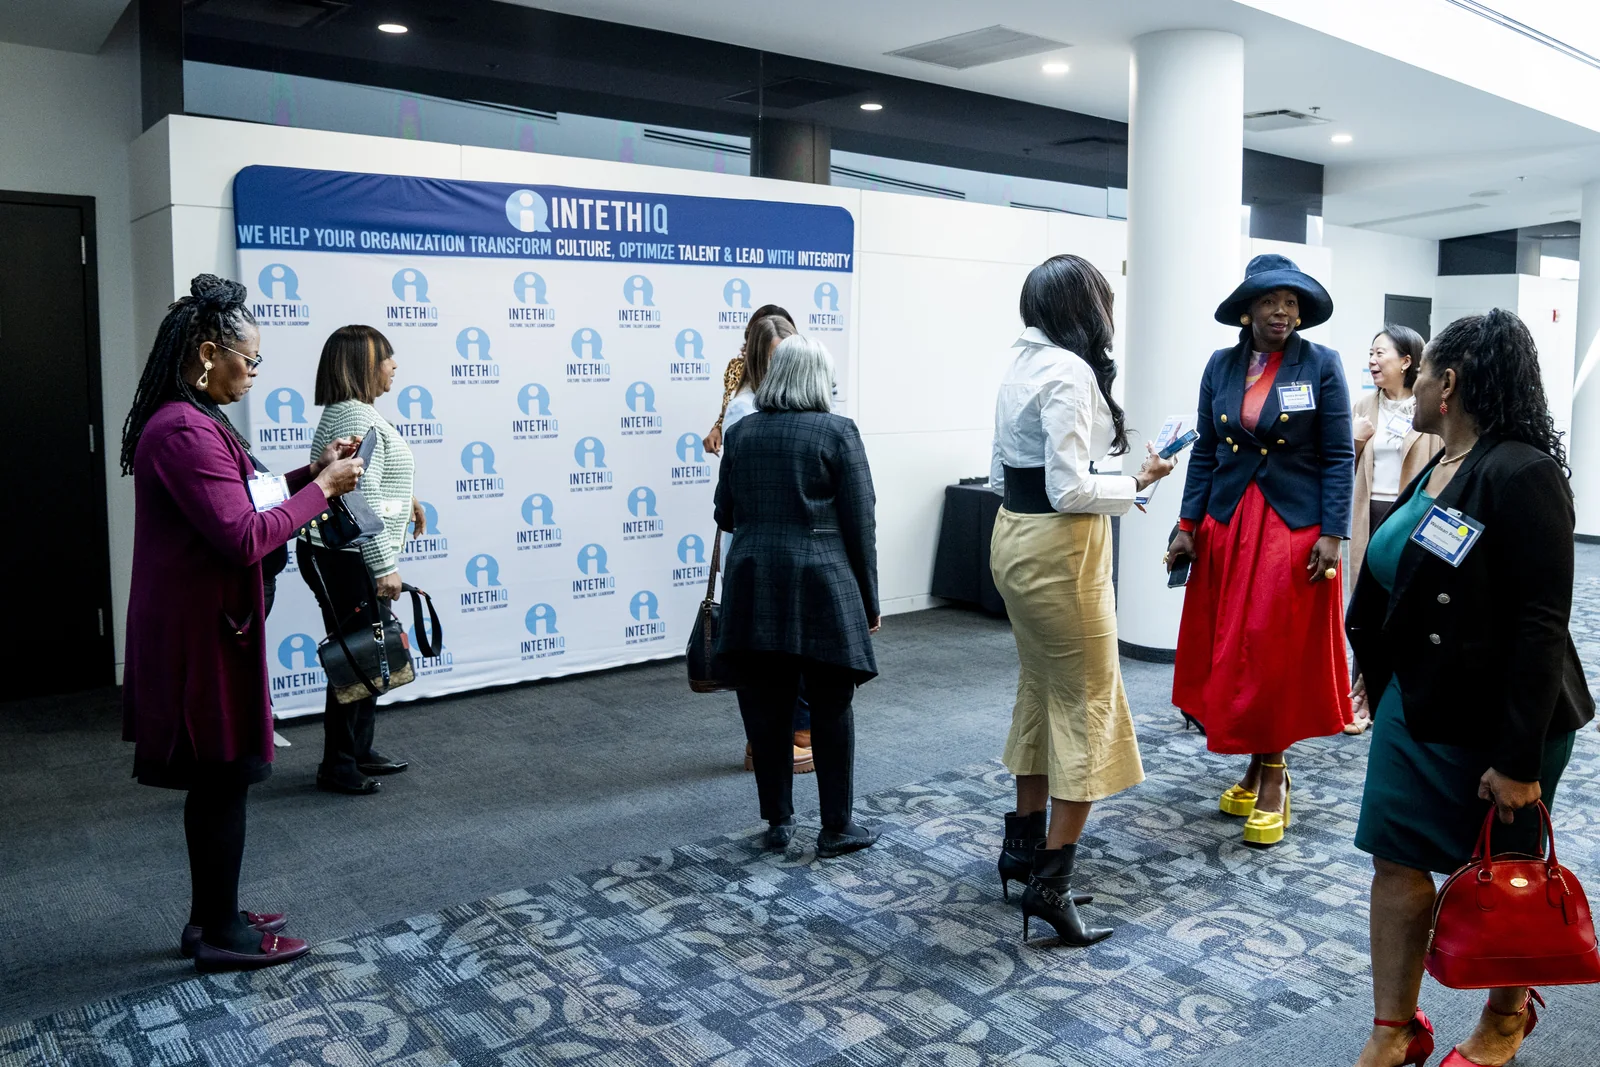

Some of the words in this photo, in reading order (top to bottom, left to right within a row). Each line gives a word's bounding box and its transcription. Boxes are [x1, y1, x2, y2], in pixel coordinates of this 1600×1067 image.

[552, 197, 668, 235] INTETHIQ
[237, 225, 264, 244] WE
[270, 226, 310, 246] HELP
[314, 228, 355, 248] YOUR
[360, 231, 465, 253] ORGANIZATION
[469, 235, 551, 256] TRANSFORM
[556, 239, 615, 260] CULTURE,
[619, 242, 675, 260] OPTIMIZE
[678, 244, 721, 262] TALENT
[724, 247, 733, 262] &
[736, 247, 764, 264] LEAD
[767, 249, 795, 265] WITH
[798, 250, 851, 269] INTEGRITY
[253, 304, 309, 318] INTETHIQ
[387, 306, 438, 320] INTETHIQ
[509, 308, 555, 320] INTETHIQ
[618, 310, 661, 322] INTETHIQ
[718, 311, 753, 323] INTETHI
[809, 314, 844, 325] INTETHIQ
[451, 364, 500, 377] INTETHIQ
[566, 363, 610, 375] INTETHIQ
[670, 363, 710, 374] INTETHIQ
[513, 419, 559, 433] INTETHIQ
[621, 416, 662, 428] INTETHIQ
[260, 427, 315, 442] INTETHIQ
[396, 423, 443, 436] NTETHIQ
[569, 471, 613, 485] INTETHIQ
[672, 465, 711, 479] INTETHIQ
[456, 477, 504, 492] INTETHIQ
[623, 519, 664, 534] INTETHIQ
[517, 528, 562, 543] INTETHIQ
[405, 538, 448, 554] TETHIQ
[573, 576, 615, 592] INTETHIQ
[461, 588, 508, 606] INTETHIQ
[625, 621, 665, 638] INTETHIQ
[521, 635, 565, 654] INTETHIQ
[414, 652, 453, 669] TETHIQ
